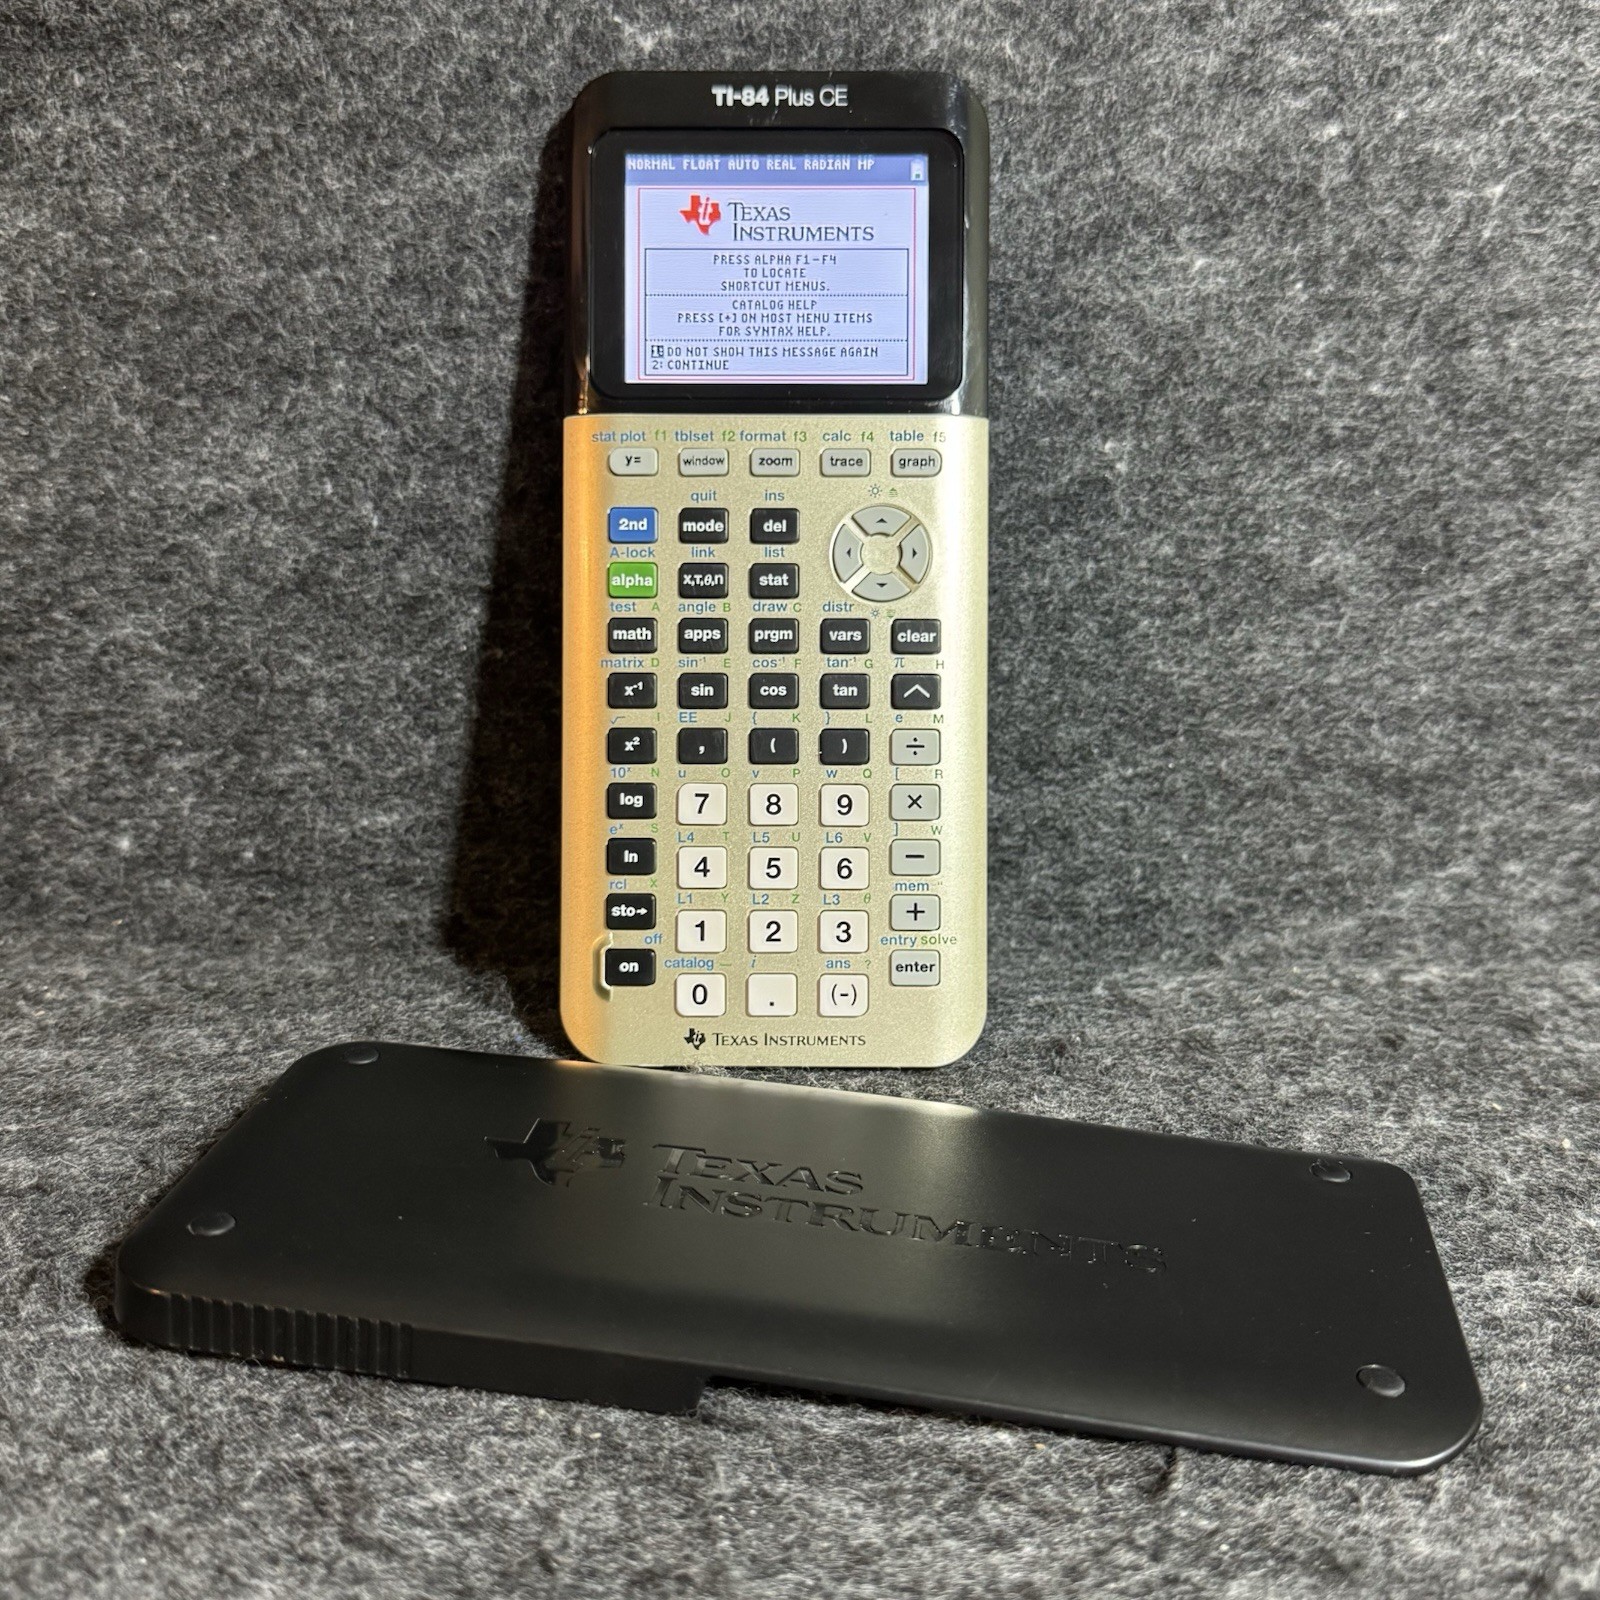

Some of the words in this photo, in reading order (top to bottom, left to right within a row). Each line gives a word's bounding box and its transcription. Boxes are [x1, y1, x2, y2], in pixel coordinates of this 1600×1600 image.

[711, 86, 770, 107] TI-84
[775, 85, 814, 107] Plus
[819, 85, 848, 107] CE
[627, 158, 676, 171] NORMAL
[683, 158, 721, 171] FLOAT
[728, 158, 759, 171] AUTO
[766, 158, 797, 171] REAL
[804, 158, 850, 171] RADIAN
[857, 158, 875, 171] MP
[727, 202, 791, 221] TEXAS
[732, 223, 875, 241] INSTRUMENTS
[713, 255, 750, 265] PRESS
[755, 255, 792, 265] ALPHA
[744, 268, 758, 278] TO
[761, 268, 806, 278] LOCATE
[721, 281, 781, 291] SHORTCUT
[785, 281, 831, 291] MENUS.
[732, 300, 784, 310] CATALOG
[788, 300, 817, 310] HELP
[677, 313, 714, 323] PRESS
[741, 313, 757, 323] ON
[760, 313, 791, 323] MOST
[795, 313, 830, 323] MENU
[833, 313, 873, 323] ITEMS
[718, 326, 741, 337] FOR
[745, 326, 794, 337] SYNTAX
[797, 326, 832, 337] HELP.
[667, 347, 682, 358] DO
[686, 347, 709, 358] NOT
[712, 347, 747, 358] SHOW
[749, 347, 779, 358] THIS
[782, 347, 836, 358] MESSAGE
[840, 347, 878, 358] AGAIN
[667, 360, 729, 370] CONTINUE
[592, 431, 616, 442] stat
[620, 430, 646, 444] plot
[655, 431, 667, 441] f1
[675, 431, 714, 442] tblset
[722, 431, 735, 442] f2
[740, 431, 786, 442] format
[793, 431, 807, 442] f3
[822, 430, 851, 442] calc
[861, 431, 874, 442] f4
[890, 430, 924, 442] table
[933, 432, 946, 443] f5
[625, 455, 641, 466] y=
[683, 456, 725, 466] window
[758, 458, 792, 467] zoom
[830, 456, 863, 466] trace
[899, 456, 936, 469] graph
[691, 490, 717, 503] quit
[765, 490, 785, 501] ins
[618, 518, 647, 530] 2nd
[683, 519, 724, 532] mode
[763, 520, 787, 532] del
[610, 547, 656, 558] A-lock
[691, 547, 715, 557] link
[764, 547, 785, 558] list
[612, 574, 653, 588] alpha
[759, 574, 789, 586] stat
[610, 603, 636, 612] test
[651, 603, 660, 612] A
[678, 602, 716, 614] angle
[723, 603, 731, 612] B
[753, 602, 787, 612] draw
[793, 603, 802, 613] C
[822, 602, 855, 612] distr
[613, 628, 651, 640] math
[684, 629, 721, 641] apps
[754, 630, 793, 642] prgm
[829, 630, 862, 641] vars
[897, 630, 936, 643] clear
[601, 658, 644, 668] matrix
[651, 658, 659, 667] D
[723, 658, 731, 668] E
[794, 659, 801, 668] F
[864, 659, 873, 669] G
[936, 660, 944, 669] H
[691, 684, 714, 696] sin
[760, 685, 787, 696] cos
[833, 684, 858, 696] tan
[679, 712, 697, 723] EE
[792, 713, 801, 722] K
[866, 714, 872, 723] L
[895, 714, 903, 722] e
[933, 715, 944, 723] M
[651, 768, 659, 777] N
[679, 770, 686, 778] u
[793, 769, 800, 778] P
[863, 769, 872, 779] Q
[935, 769, 943, 778] R
[620, 793, 643, 807] log
[694, 793, 709, 814] 7
[766, 794, 781, 814] 8
[837, 794, 853, 815] 9
[723, 832, 730, 840] T
[931, 826, 943, 835] W
[678, 832, 694, 843] L4
[753, 832, 770, 843] L5
[792, 833, 800, 842] U
[826, 832, 843, 843] L6
[694, 856, 710, 878] 4
[766, 858, 782, 878] 5
[836, 858, 853, 879] 6
[610, 879, 627, 889] rcl
[894, 882, 929, 891] mem
[678, 894, 693, 904] L1
[721, 893, 729, 902] Y
[752, 894, 769, 904] L2
[792, 894, 799, 903] Z
[823, 895, 840, 905] L3
[695, 921, 705, 941] 1
[766, 921, 781, 942] 2
[836, 922, 851, 943] 3
[644, 934, 663, 944] off
[880, 935, 917, 947] entry
[921, 935, 957, 945] solve
[619, 961, 639, 972] on
[664, 958, 714, 970] catalog
[826, 960, 850, 969] ans
[895, 962, 935, 972] enter
[692, 984, 708, 1005] 0
[712, 1033, 758, 1046] TEXAS
[764, 1034, 866, 1046] INSTRUMENTS
[653, 1143, 864, 1195] TEXAS
